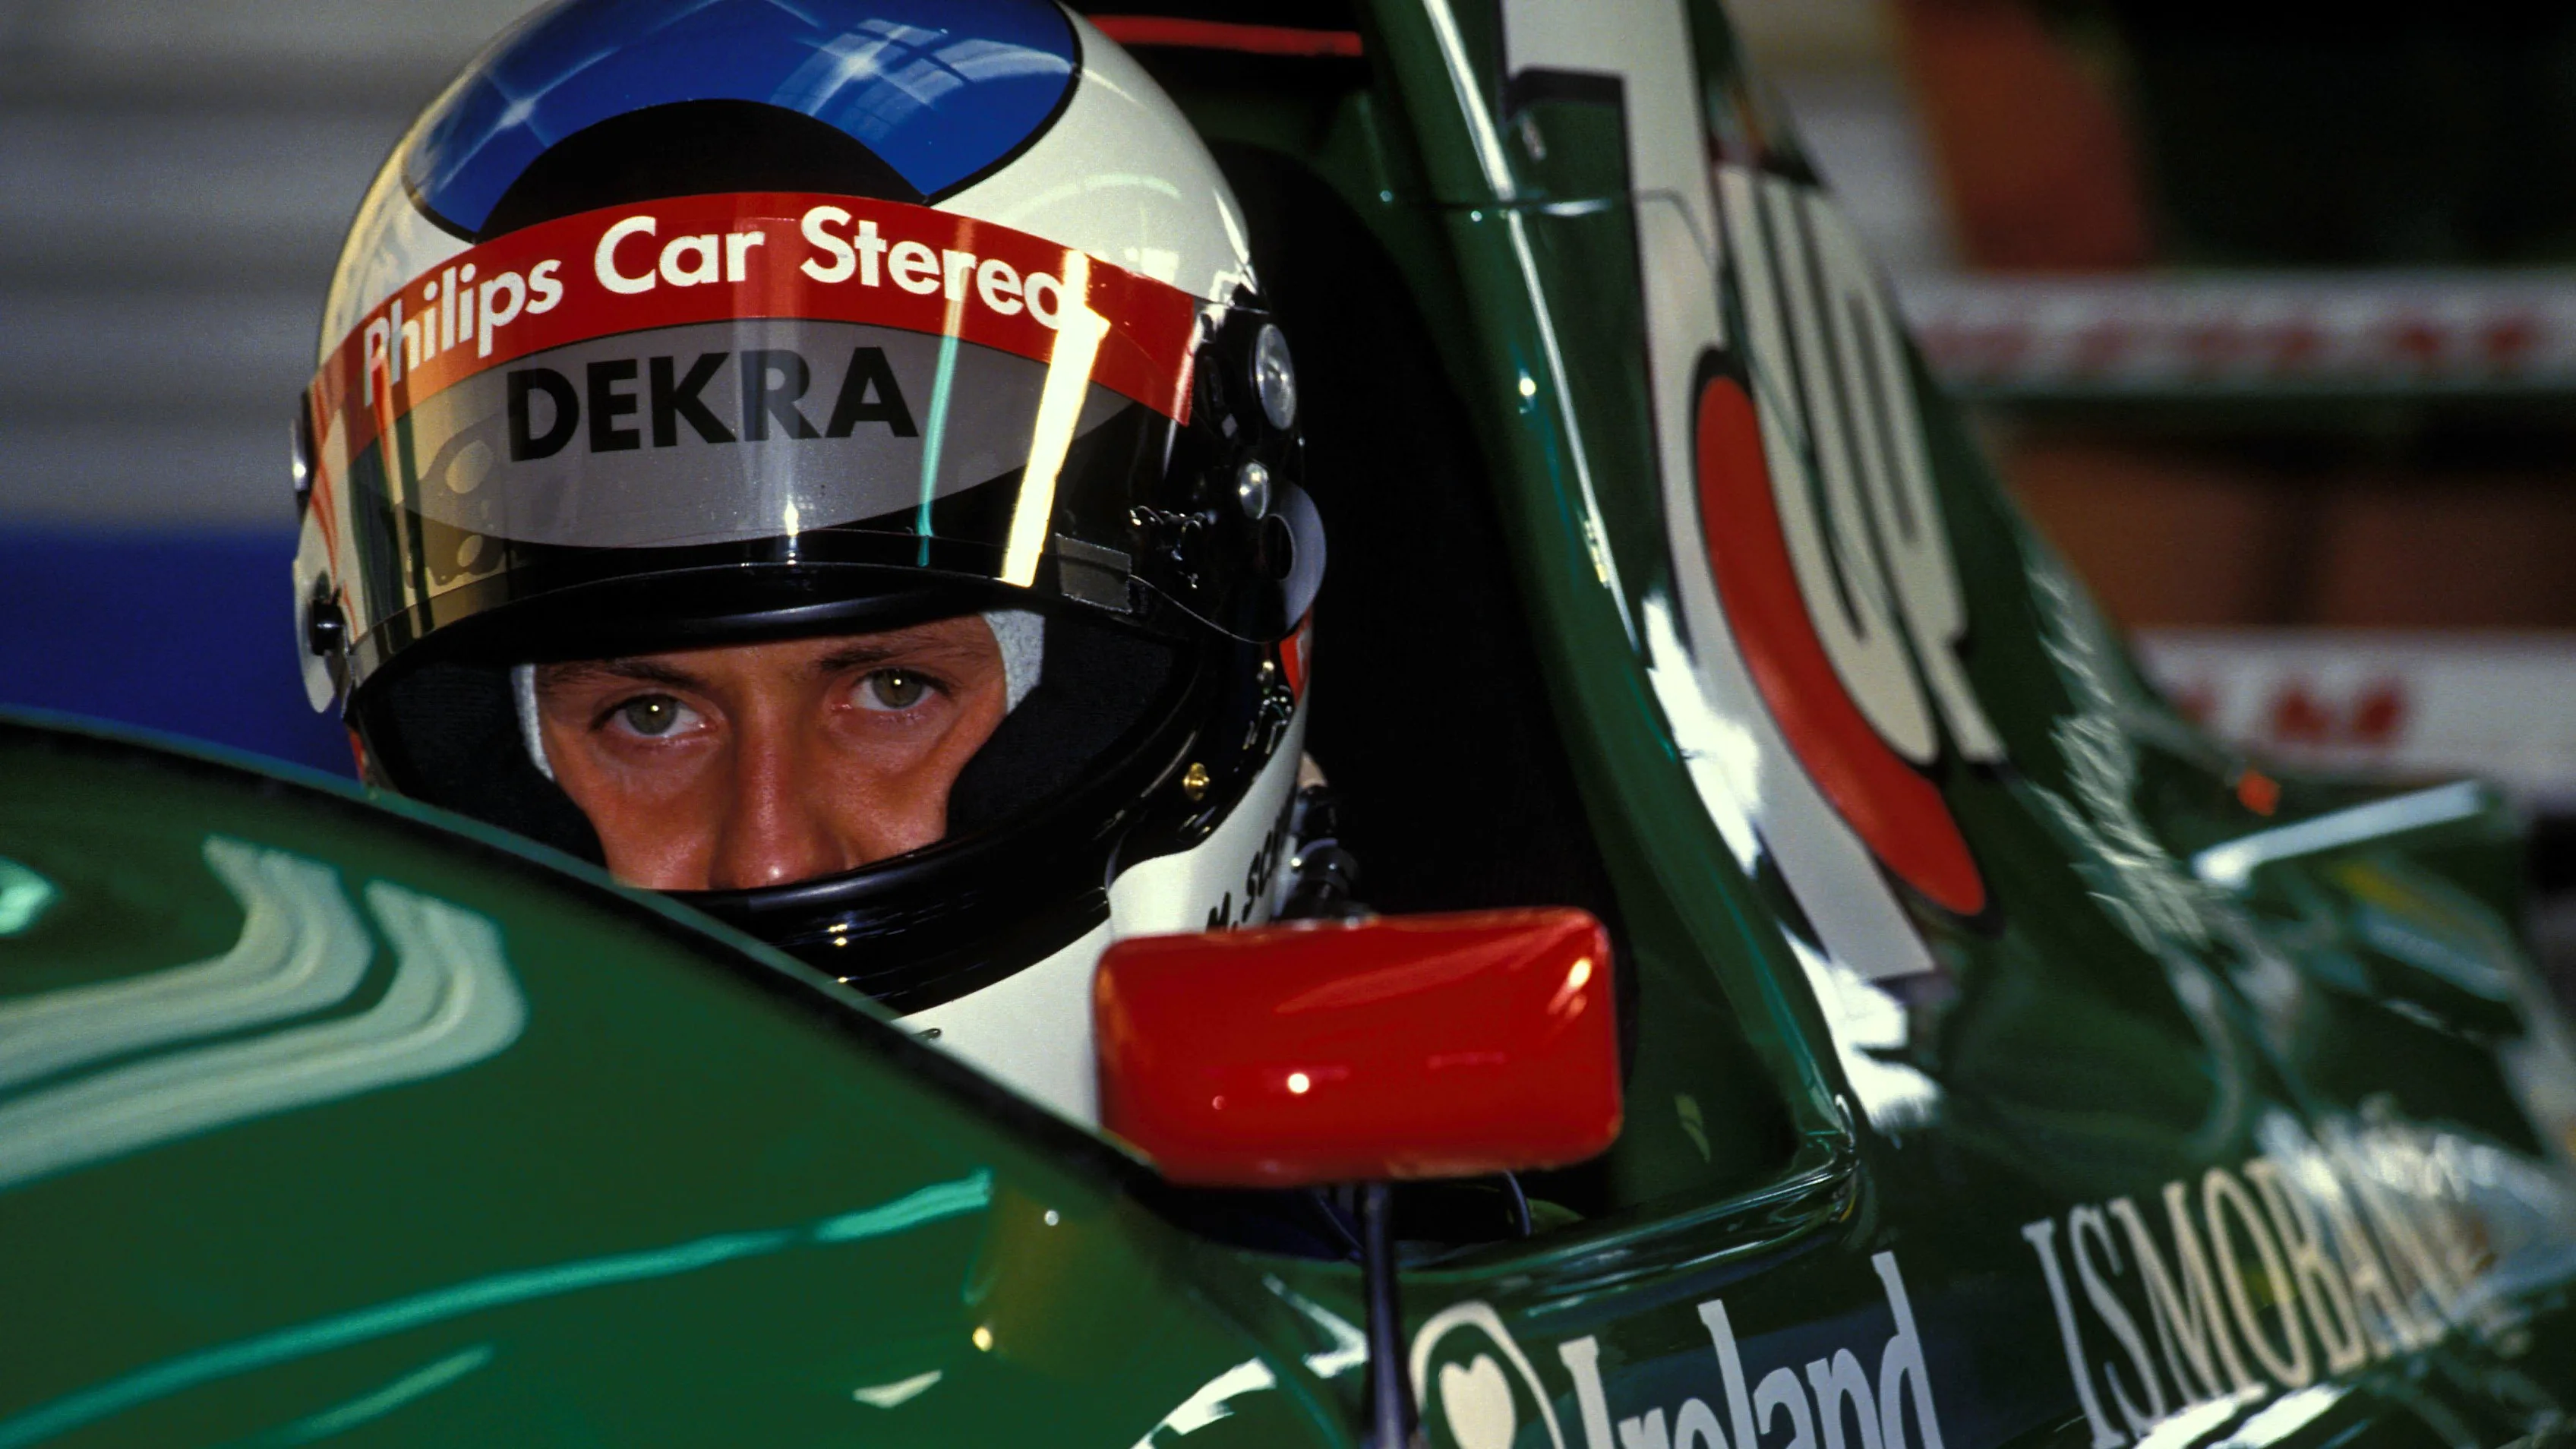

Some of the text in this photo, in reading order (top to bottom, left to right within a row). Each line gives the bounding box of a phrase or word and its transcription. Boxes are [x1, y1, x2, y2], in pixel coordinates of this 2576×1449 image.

[364, 205, 1067, 408] Philips Car Stereo
[507, 346, 920, 462] DEKRA
